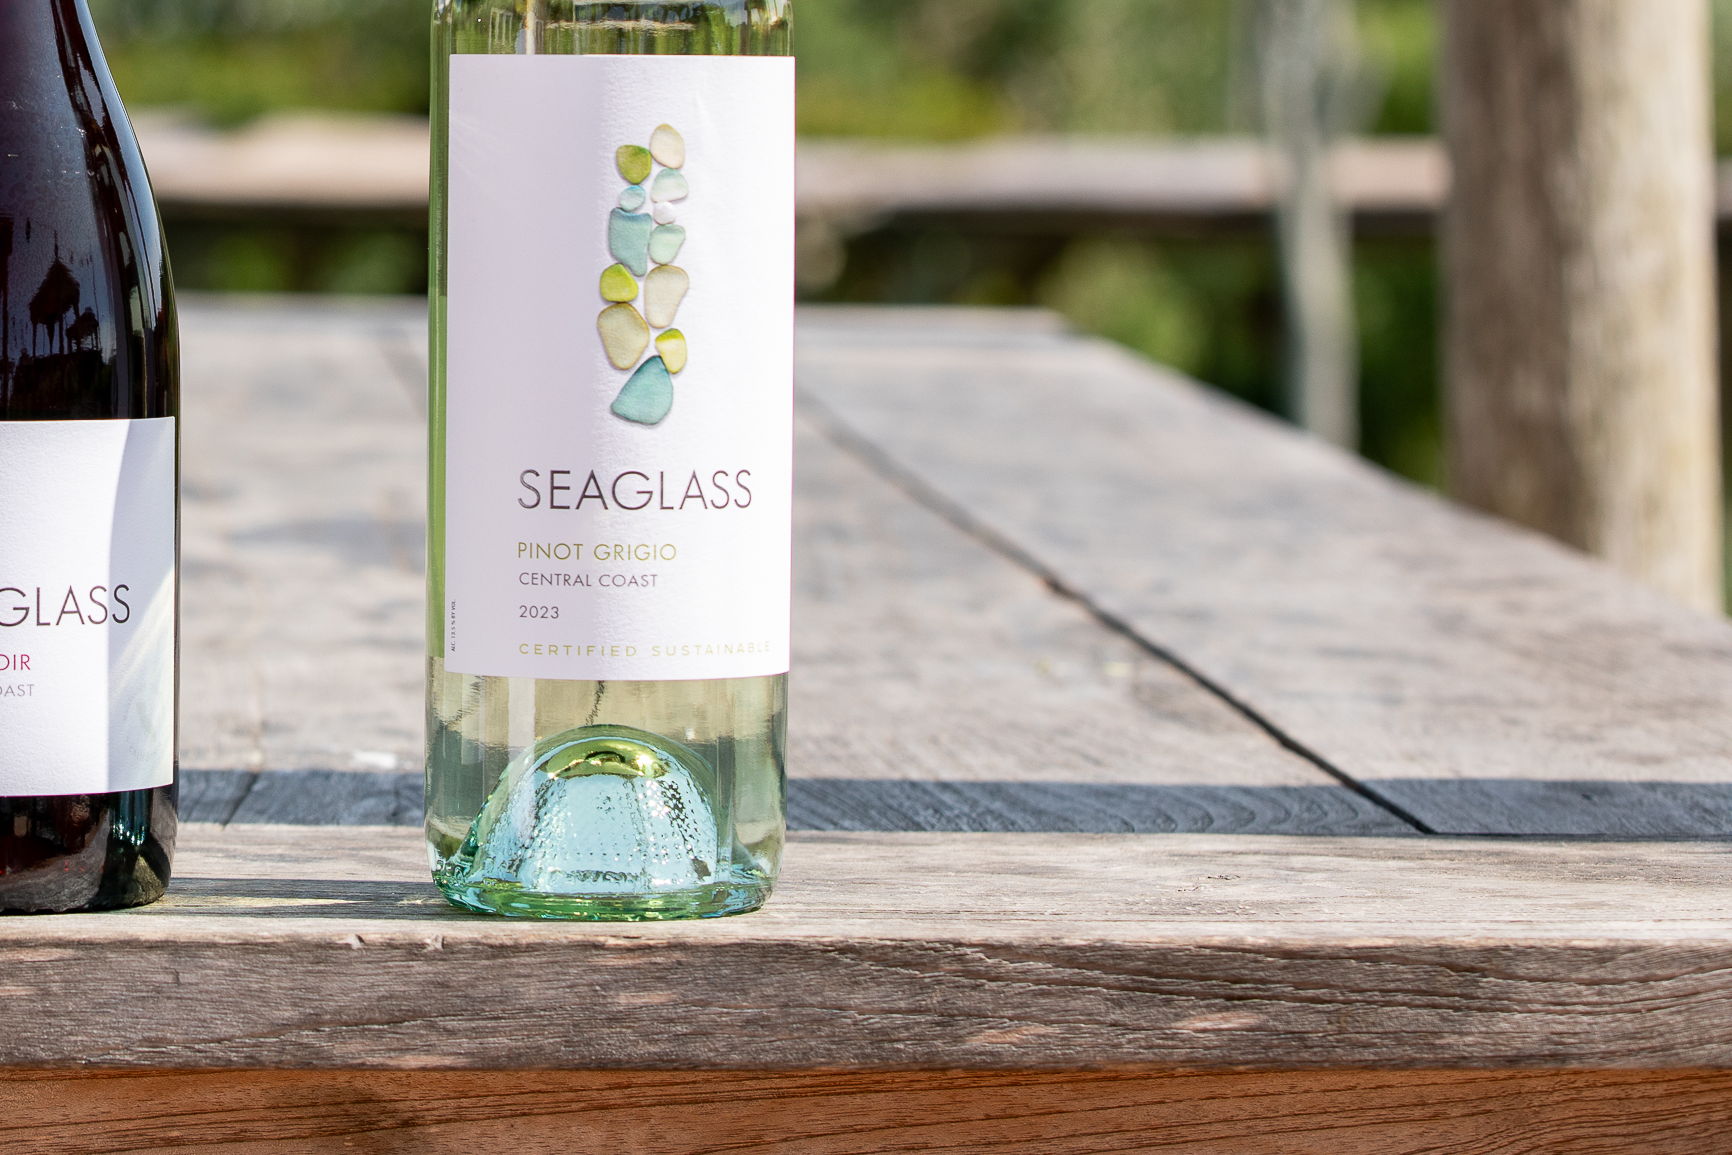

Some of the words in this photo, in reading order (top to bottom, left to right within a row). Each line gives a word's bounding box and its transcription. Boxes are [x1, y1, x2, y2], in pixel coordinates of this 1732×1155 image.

[517, 468, 753, 511] SEAGLASS
[517, 542, 584, 561] PINOT
[593, 543, 678, 562] GRIGIO
[518, 572, 593, 588] CENTRAL
[598, 573, 659, 588] COAST
[519, 605, 560, 619] 2023
[519, 643, 638, 658] CERTIFIED
[652, 640, 772, 658] SUSTAINABLE
